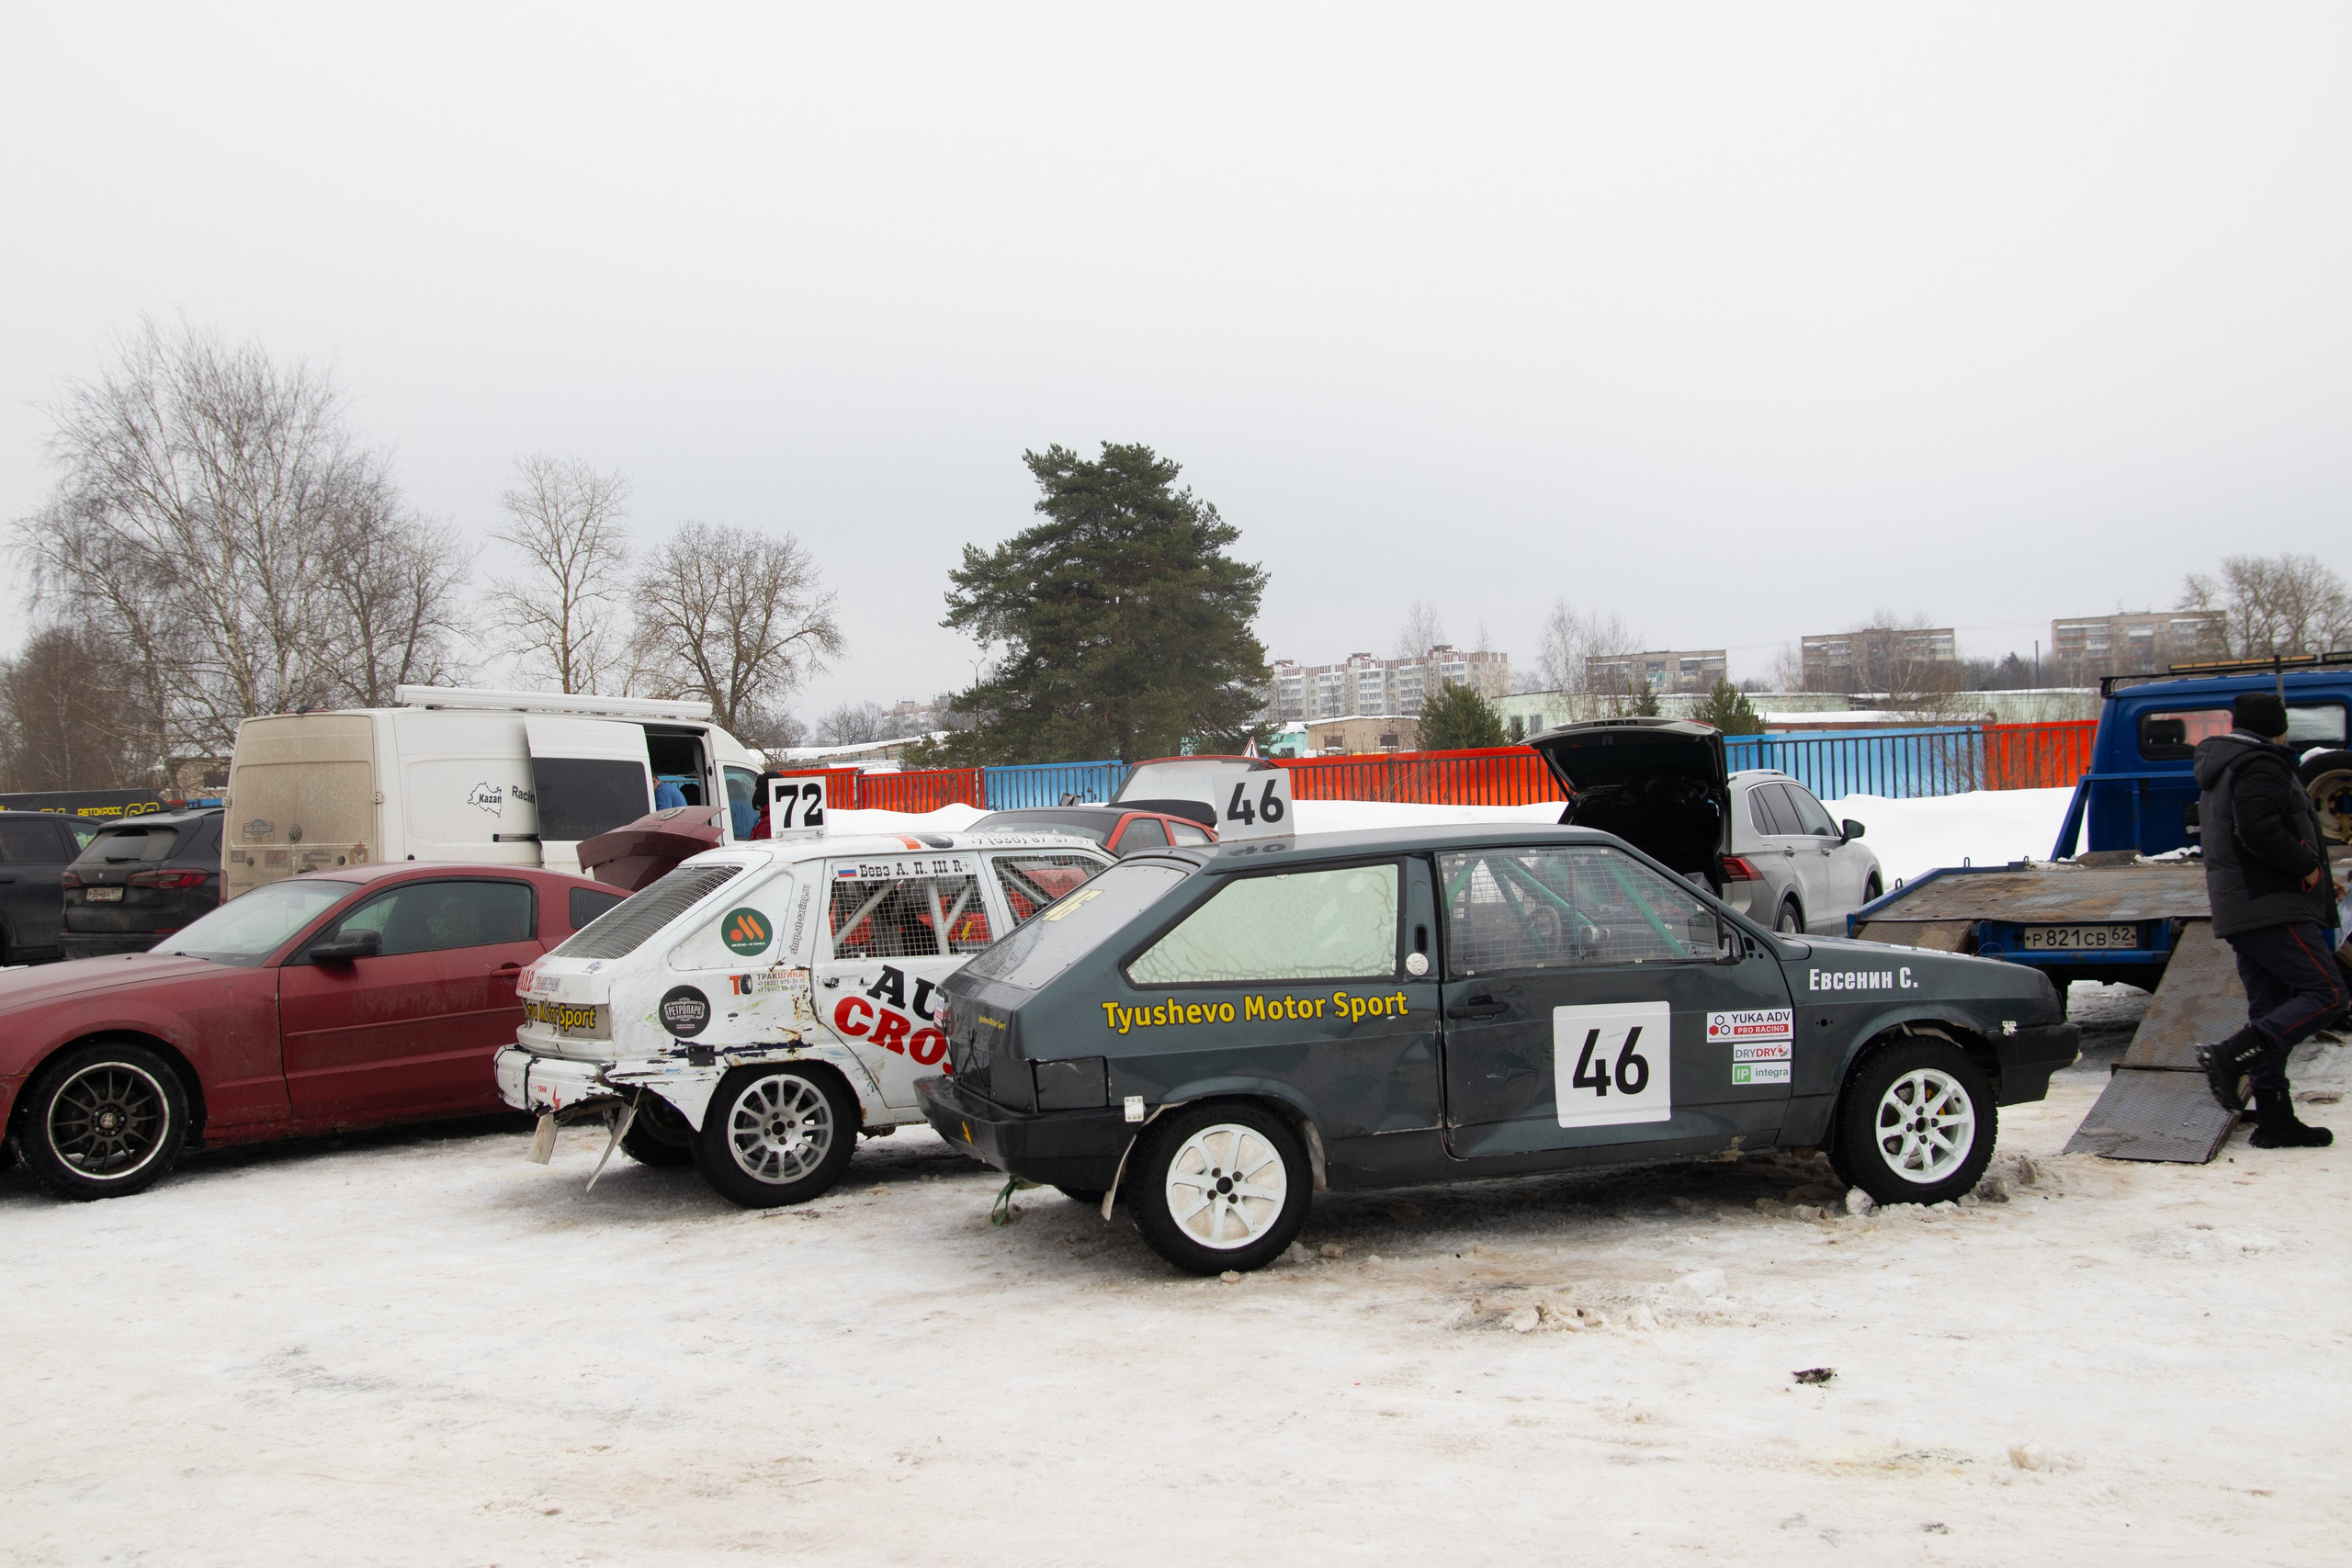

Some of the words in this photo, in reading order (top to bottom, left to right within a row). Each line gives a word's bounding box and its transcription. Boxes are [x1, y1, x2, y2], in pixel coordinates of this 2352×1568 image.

[479, 793, 503, 804] Kazan
[775, 783, 824, 829] 72
[1227, 778, 1284, 826] 46
[858, 863, 891, 878] Бевз
[896, 862, 910, 876] А.
[913, 861, 928, 874] П.
[789, 884, 811, 955] shop.at-racing.ru
[2111, 927, 2130, 941] 62
[757, 971, 805, 980] ТРАКШИНА
[1809, 968, 1893, 991] Евсенин
[1899, 966, 1918, 988] С.
[559, 1001, 597, 1032] Sport
[668, 1004, 702, 1017] РЕТРОПАРК
[1102, 997, 1237, 1035] Tyushevo
[1243, 993, 1327, 1022] Motor
[1331, 989, 1409, 1023] Sport
[1731, 1012, 1764, 1024] YUKA
[1766, 1011, 1791, 1022] ADV
[833, 996, 954, 1075] CRO
[1755, 1025, 1785, 1033] RACING
[1735, 1047, 1777, 1058] DRYDRY
[1572, 1026, 1650, 1097] 46
[1736, 1068, 1749, 1080] IP
[1755, 1068, 1789, 1078] integra
